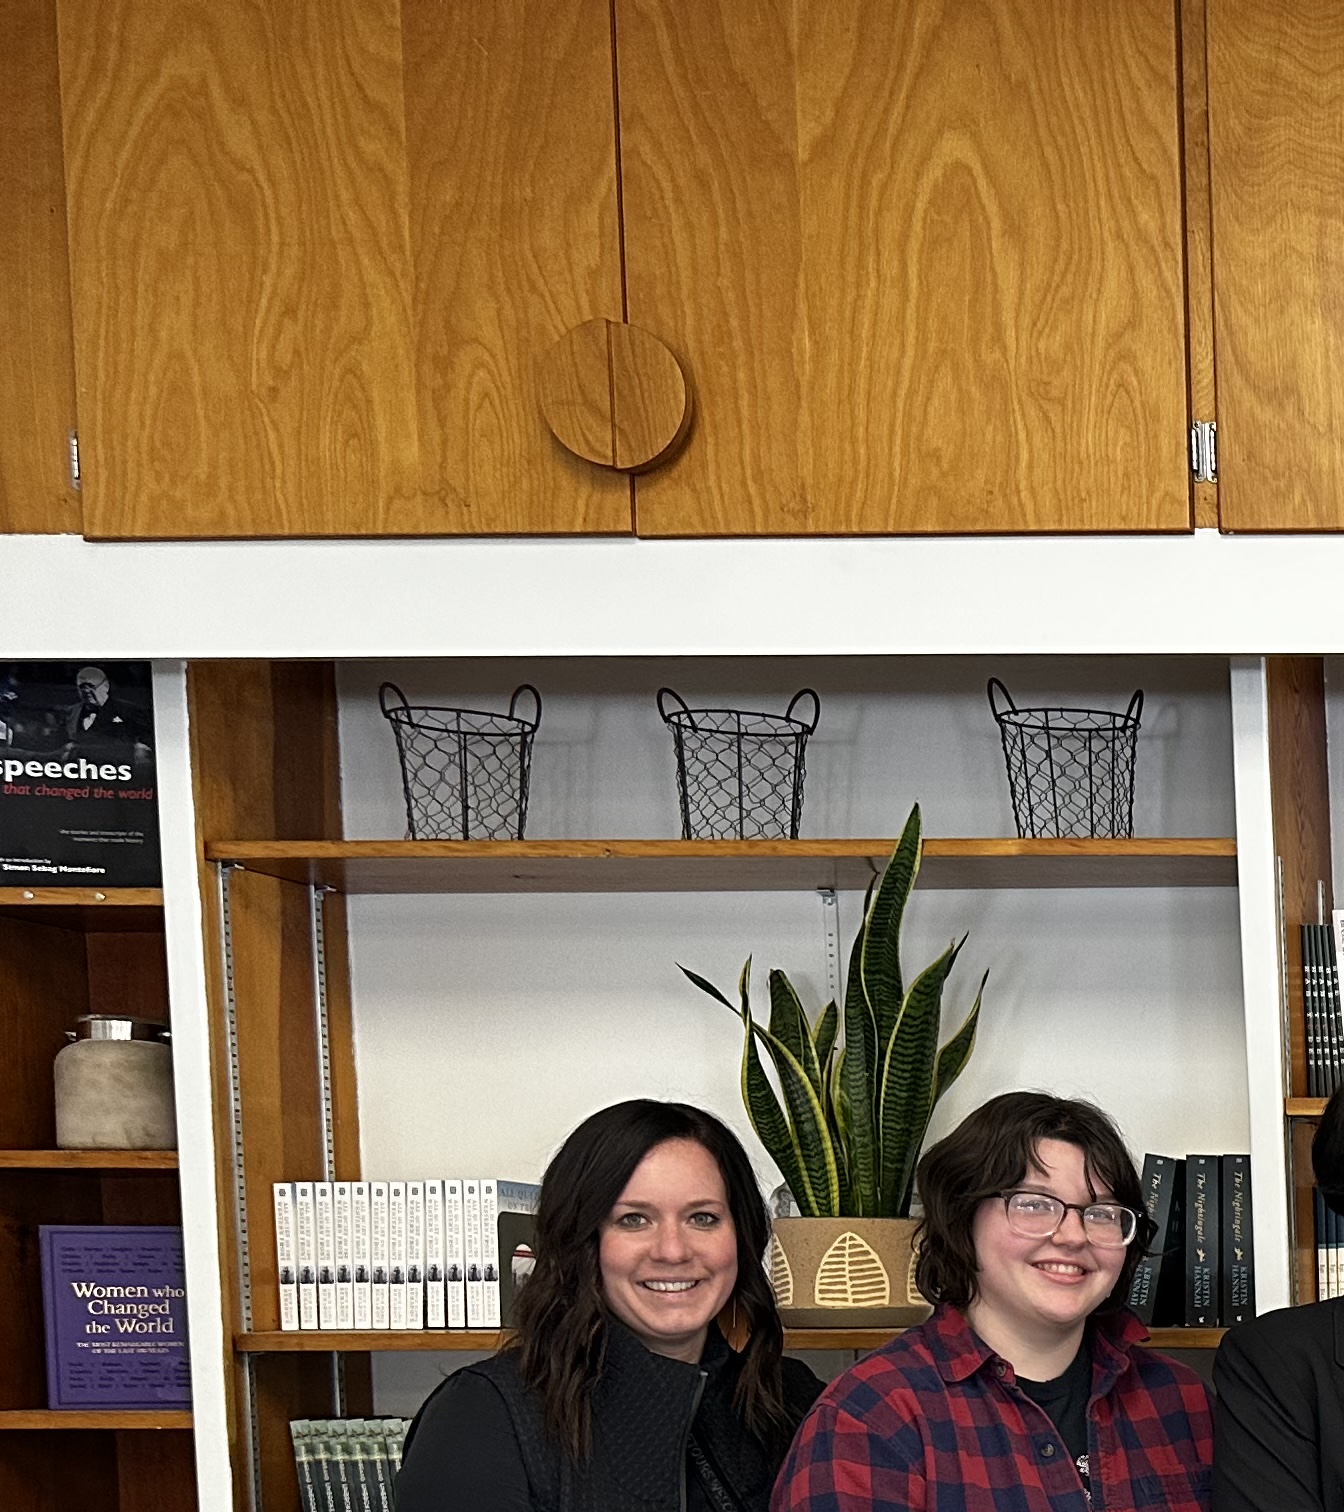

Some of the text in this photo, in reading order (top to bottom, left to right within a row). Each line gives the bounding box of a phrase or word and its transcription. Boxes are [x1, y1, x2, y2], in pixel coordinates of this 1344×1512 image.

[4, 784, 153, 800] that changed the world
[1196, 1173, 1205, 1190] The
[1233, 1172, 1243, 1188] The
[71, 1282, 185, 1298] Women who
[1194, 1266, 1202, 1308] HANNAH
[1202, 1267, 1210, 1307] KRISTIN
[1232, 1265, 1240, 1307] HANNAH
[1240, 1266, 1248, 1305] KRISTIN
[87, 1300, 170, 1318] Changed
[85, 1318, 175, 1334] the World
